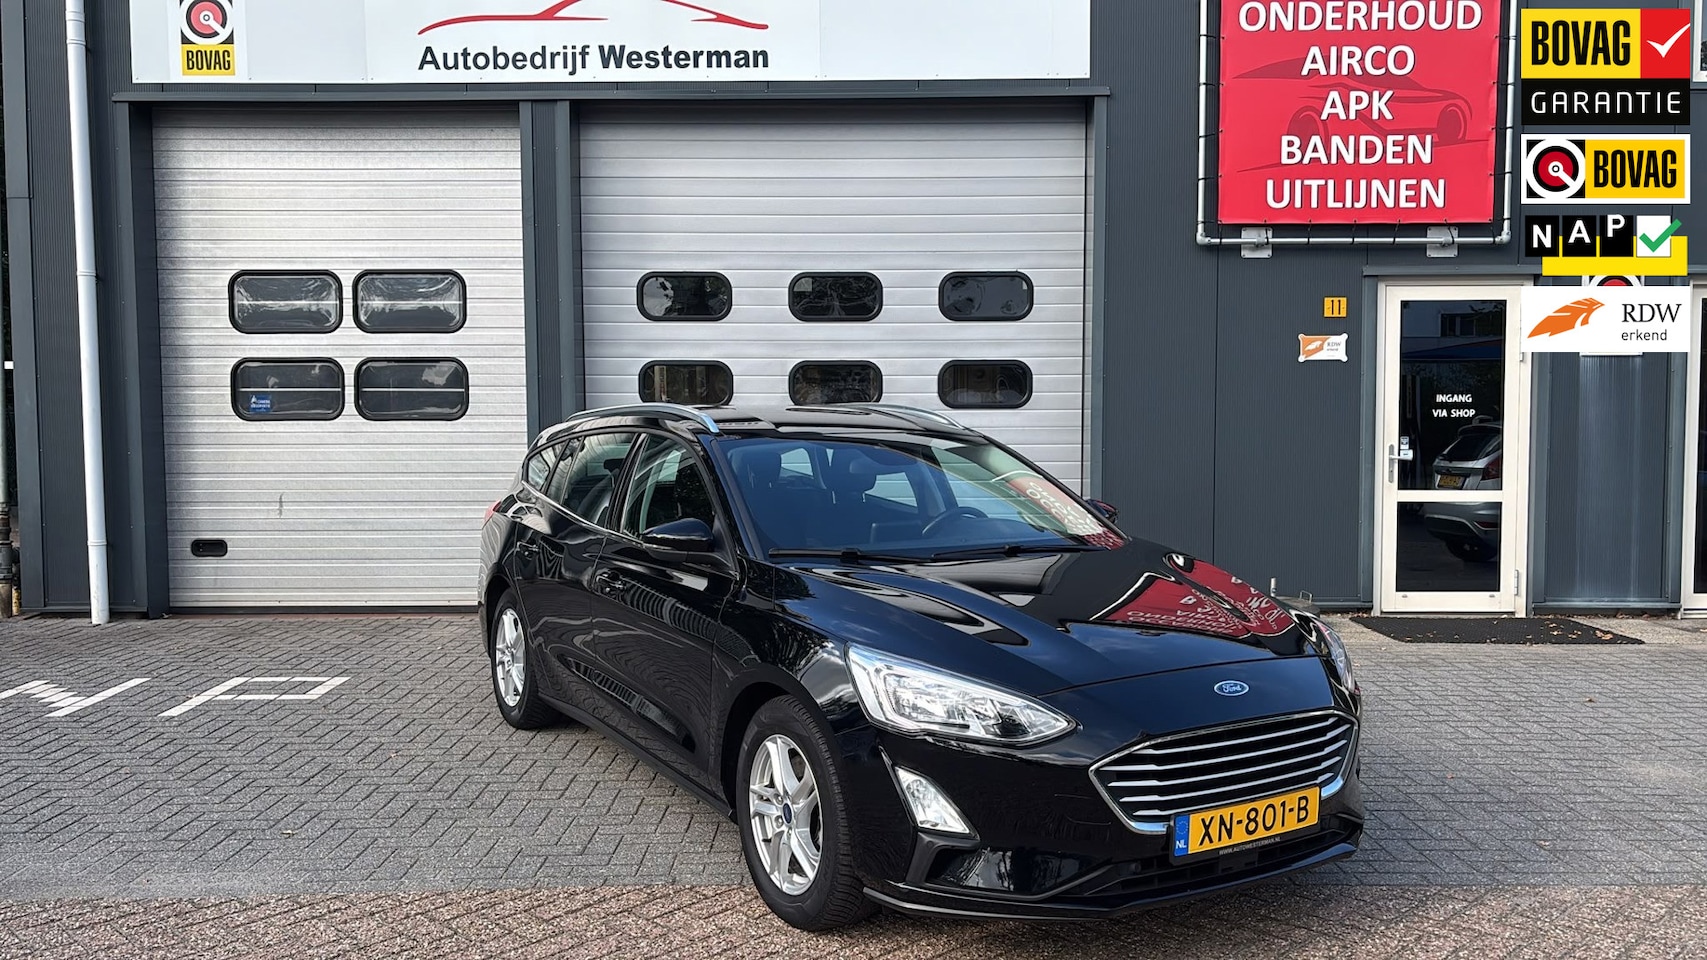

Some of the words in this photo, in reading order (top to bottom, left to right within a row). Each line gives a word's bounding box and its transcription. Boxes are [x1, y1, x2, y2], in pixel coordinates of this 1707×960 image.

[1238, 0, 1482, 31] ONDERHOUD
[186, 49, 231, 71] BOVAG
[418, 45, 590, 75] Autobedrijf
[598, 44, 769, 69] Westerman
[1300, 44, 1416, 76] AIRCO
[1320, 89, 1395, 121] APK
[1280, 134, 1434, 165] BANDEN
[1265, 178, 1447, 209] UITLIJNEN
[1330, 299, 1341, 316] 11
[1432, 409, 1448, 418] VIA
[1450, 409, 1476, 418] SHOP
[1435, 394, 1472, 403] INGANG
[1221, 683, 1241, 692] Ford
[1198, 795, 1309, 847] XN-801-B
[1175, 839, 1187, 849] NL
